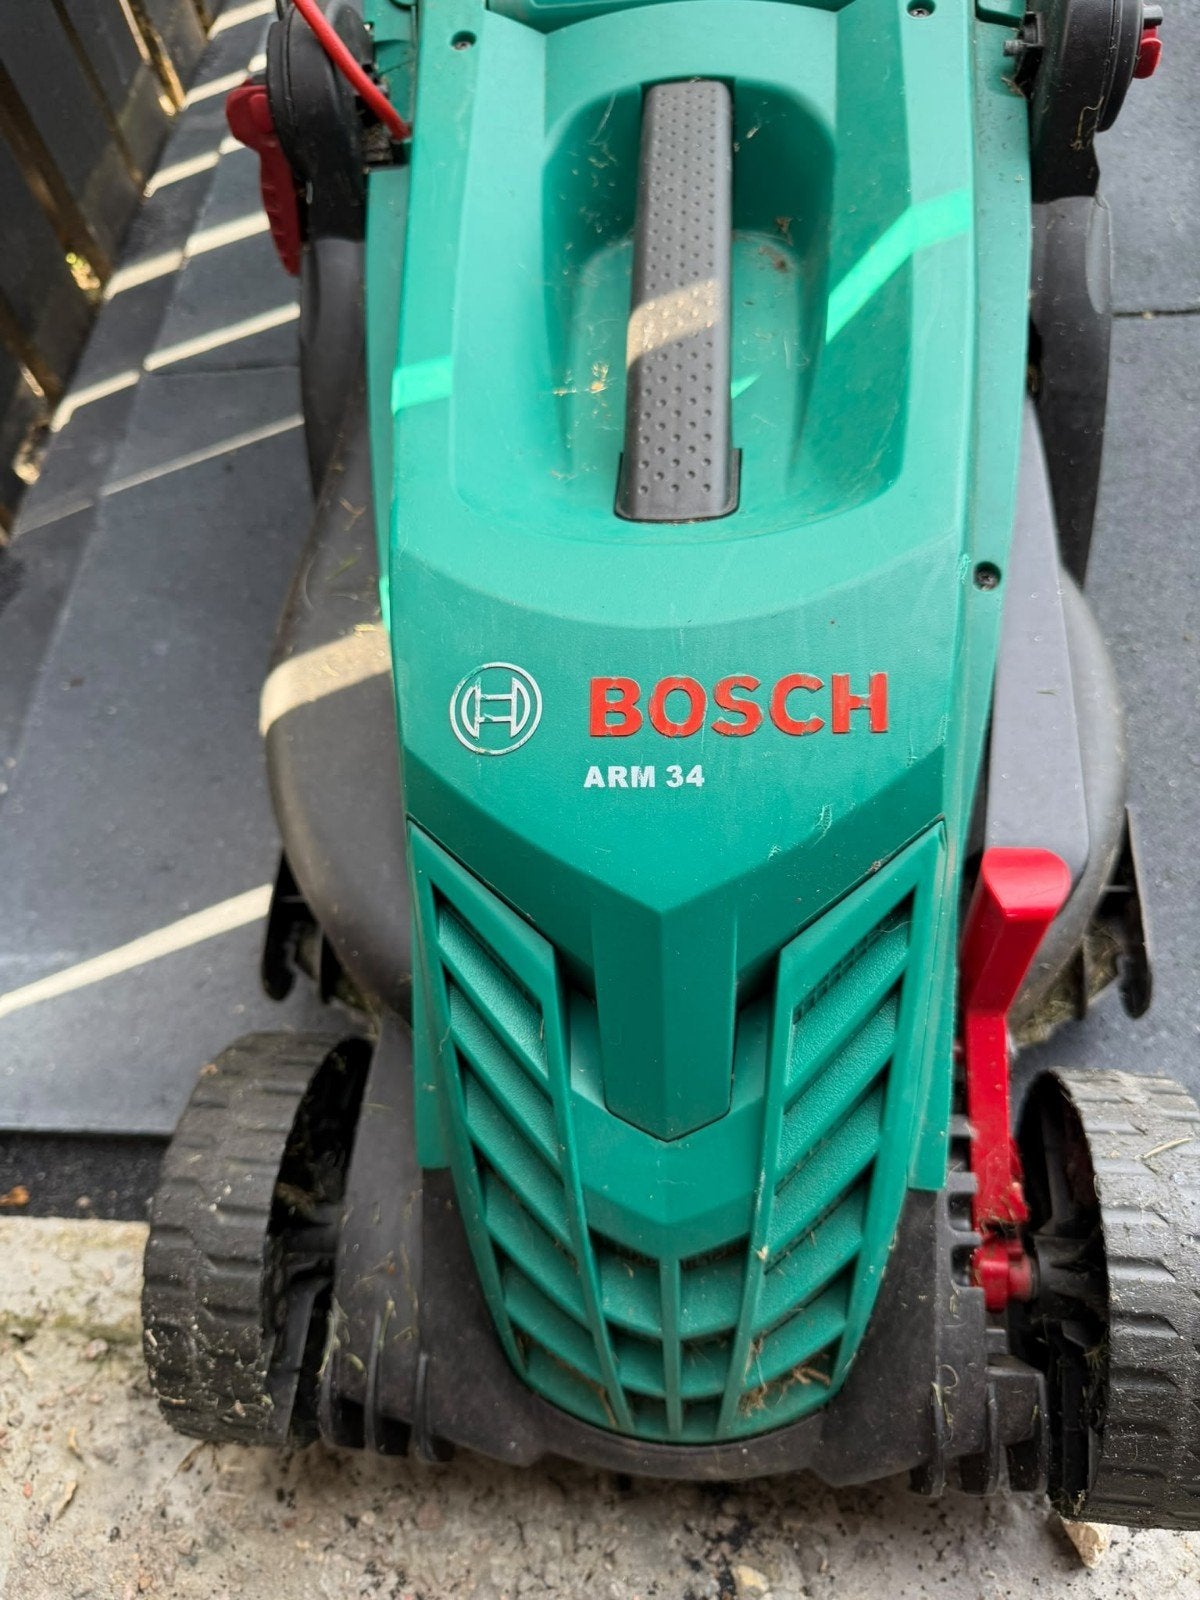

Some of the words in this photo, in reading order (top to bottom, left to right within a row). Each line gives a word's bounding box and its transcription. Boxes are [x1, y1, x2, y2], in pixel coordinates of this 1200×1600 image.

[589, 671, 889, 738] BOSCH
[583, 765, 656, 789] ARM
[665, 764, 705, 788] 34
